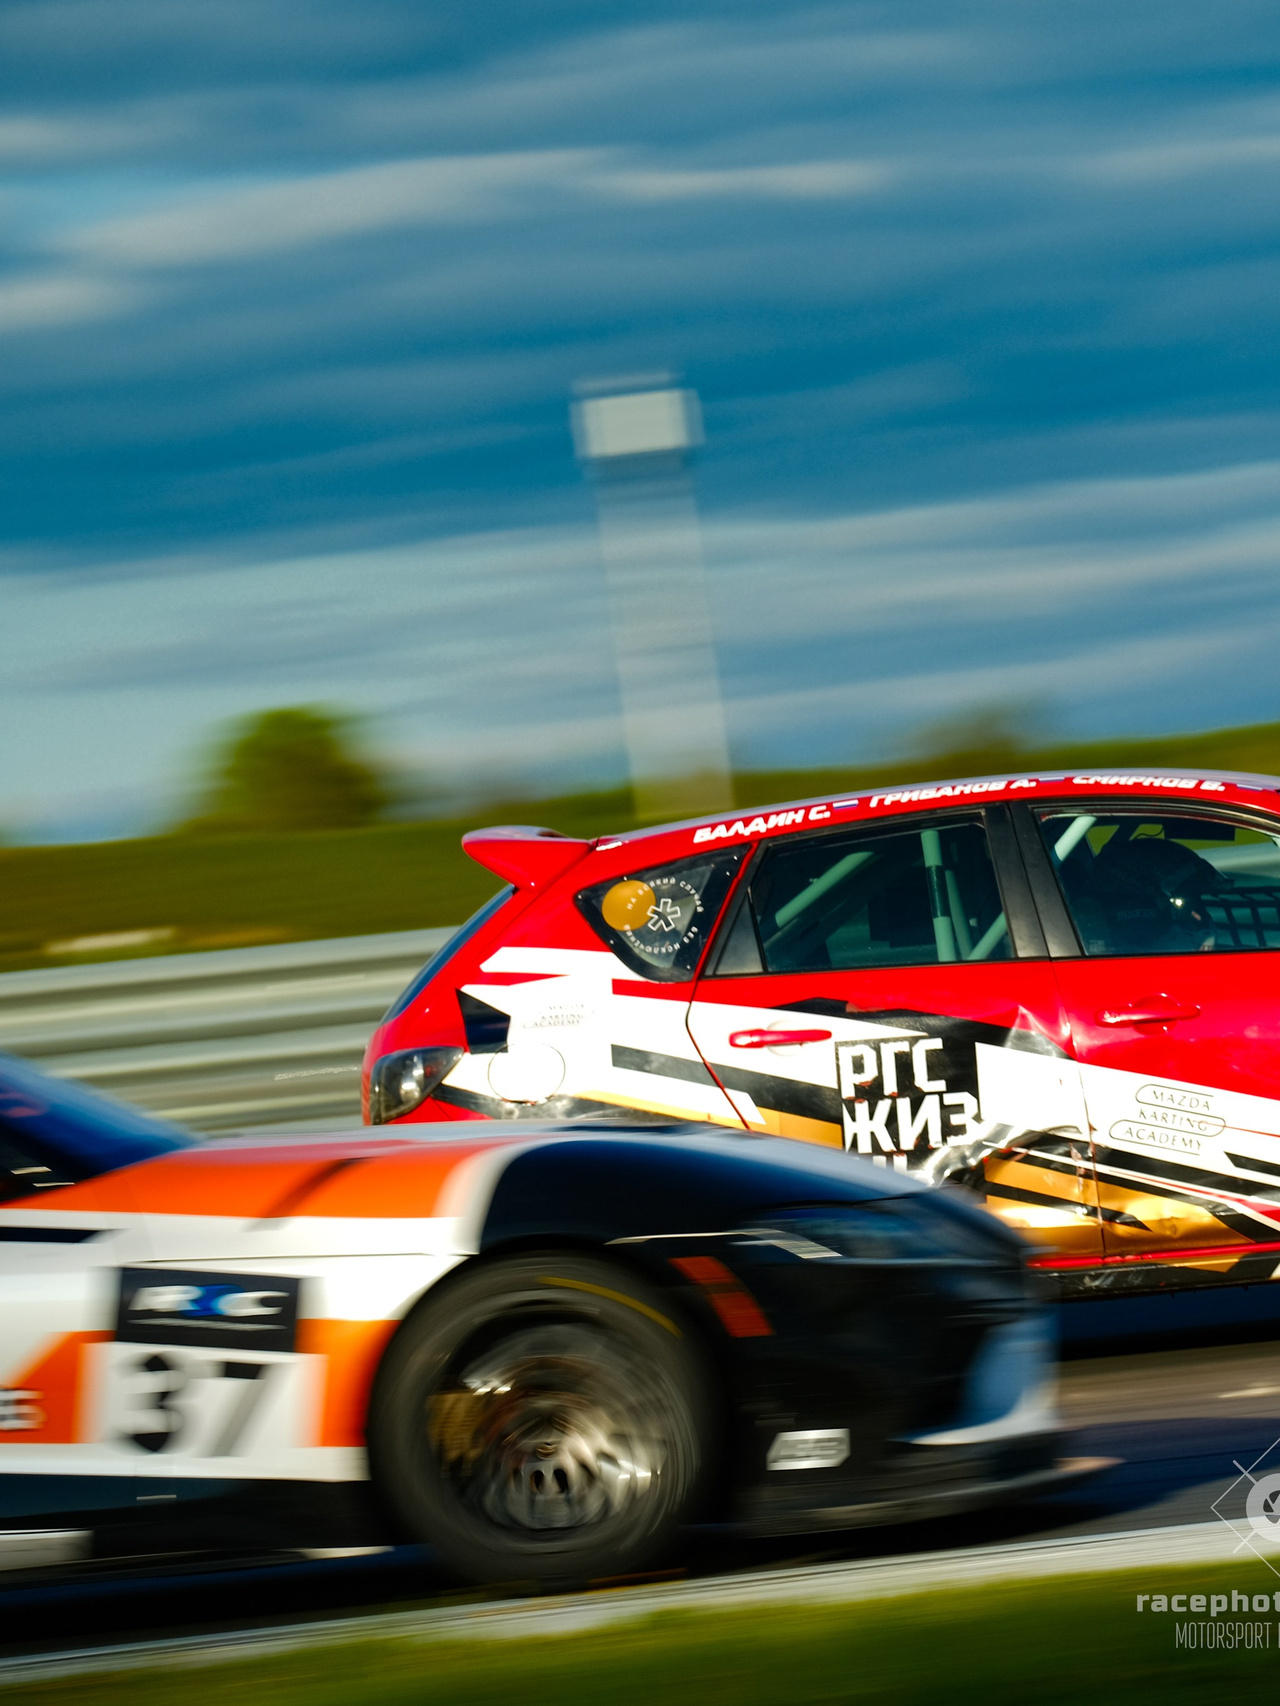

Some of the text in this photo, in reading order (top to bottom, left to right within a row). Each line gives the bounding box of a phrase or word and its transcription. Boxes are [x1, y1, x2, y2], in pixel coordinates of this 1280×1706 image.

[869, 780, 1008, 808] ГРИБАНОВ
[1072, 775, 1199, 790] СМИРНОВ
[693, 805, 831, 844] БАЛДИН С.
[838, 1037, 947, 1100] РГС
[1152, 1089, 1211, 1111] MAZDA
[842, 1091, 980, 1154] ЖИЗ
[1138, 1108, 1210, 1132] KARTING
[1124, 1126, 1203, 1151] ACADEMY
[117, 1351, 296, 1458] 37
